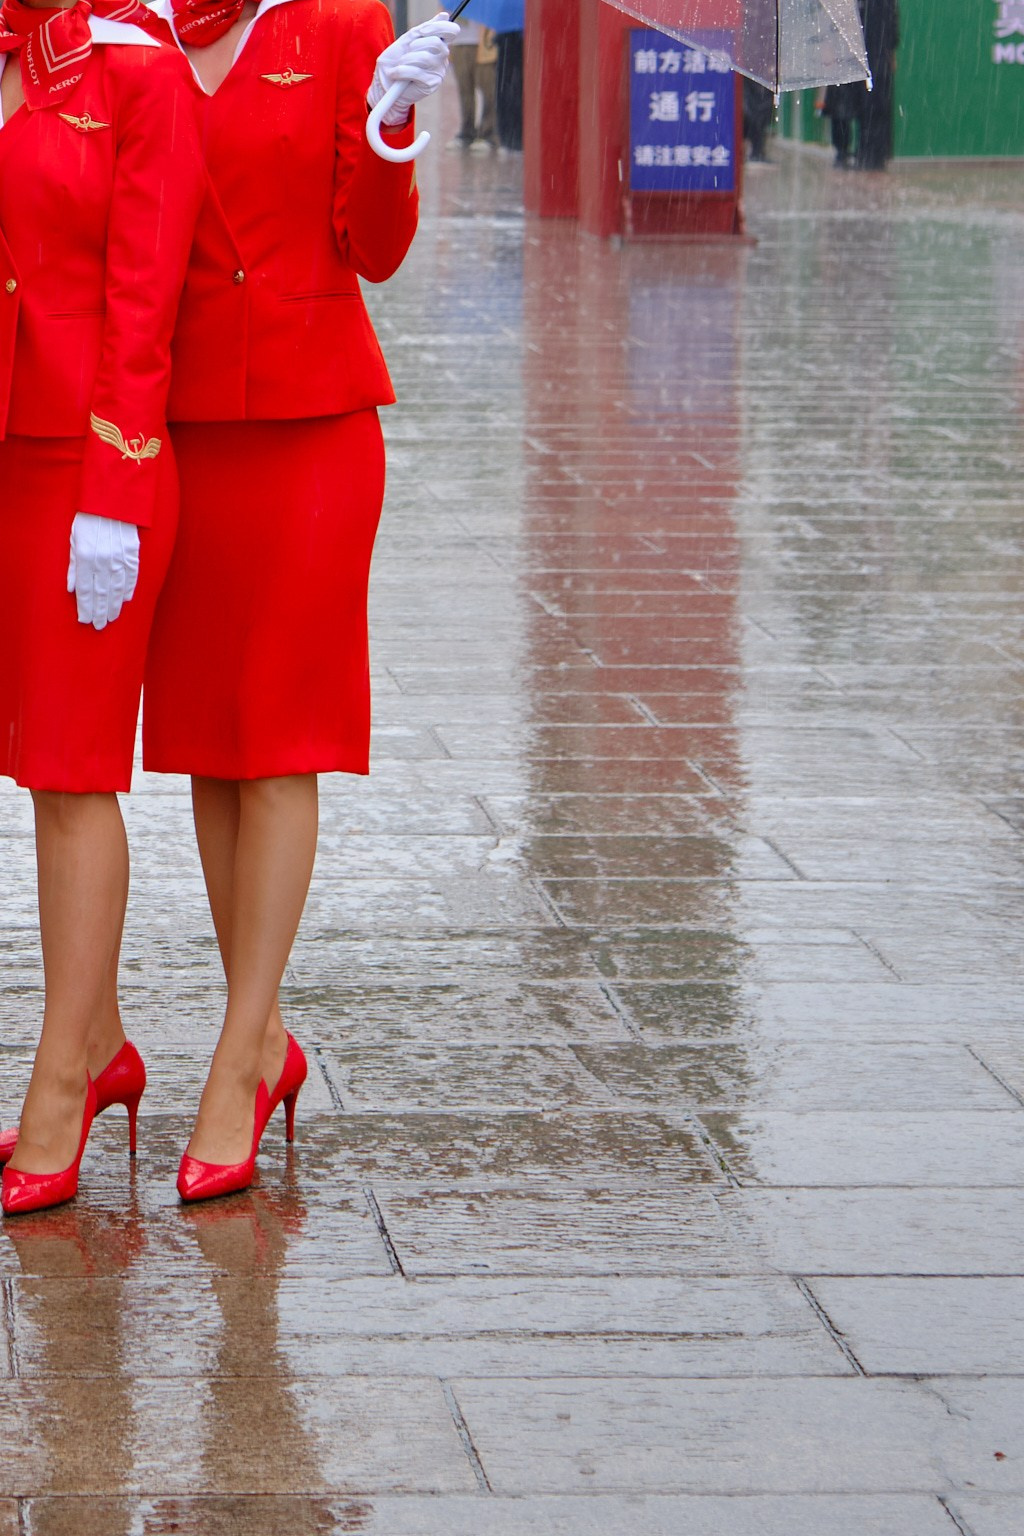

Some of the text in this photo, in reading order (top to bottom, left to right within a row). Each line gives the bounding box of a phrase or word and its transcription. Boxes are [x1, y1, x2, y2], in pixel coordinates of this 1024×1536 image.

[649, 91, 716, 122] 通行
[633, 145, 731, 167] 请注意安全
